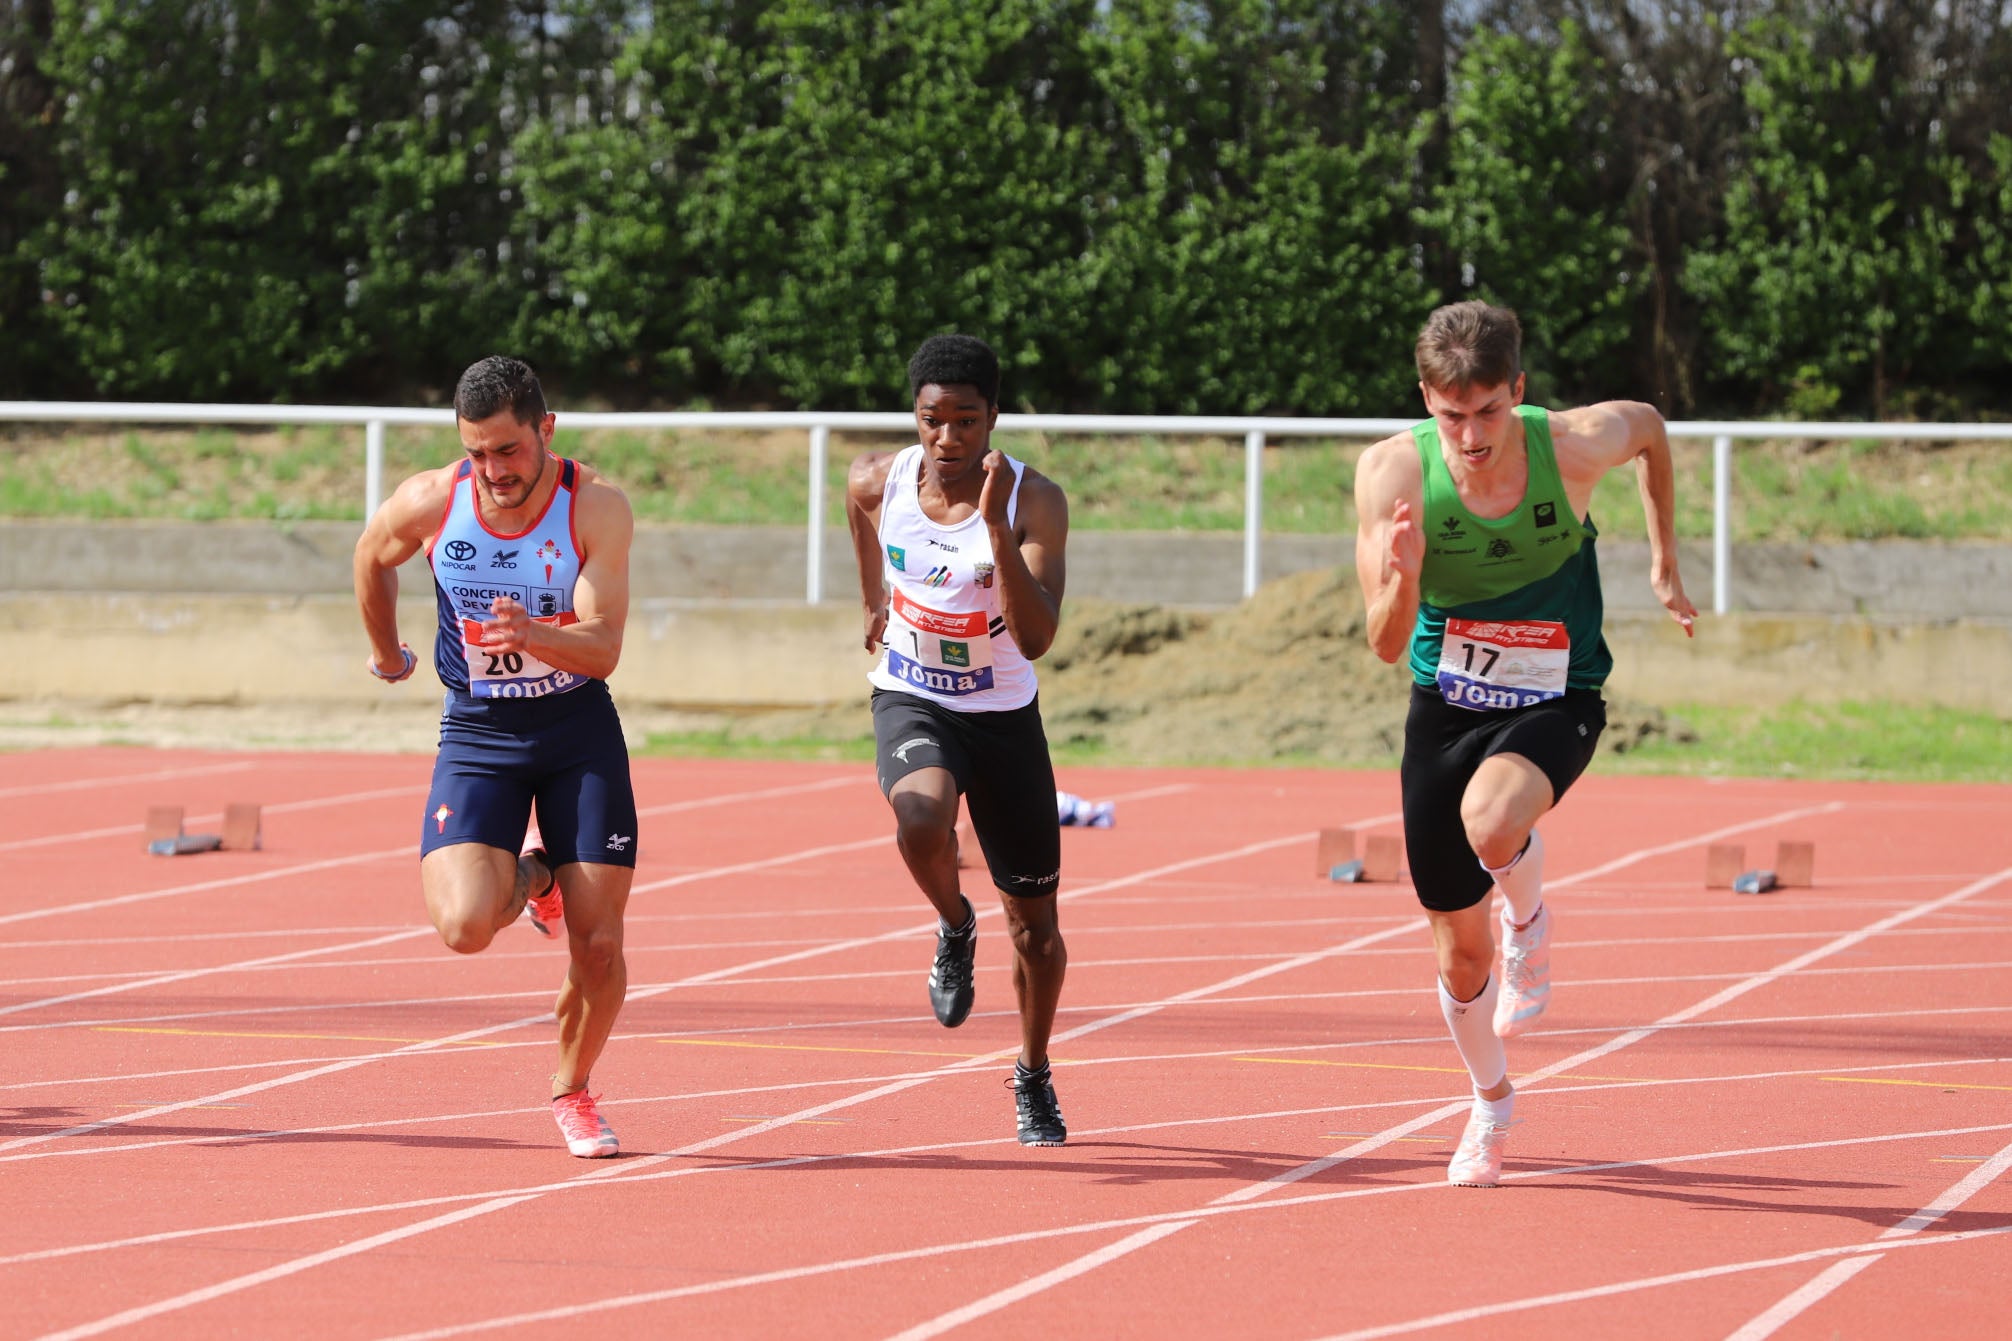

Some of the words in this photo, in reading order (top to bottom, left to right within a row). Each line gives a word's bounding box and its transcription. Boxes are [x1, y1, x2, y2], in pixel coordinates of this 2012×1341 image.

[441, 560, 476, 571] NIPOCAR
[462, 600, 479, 610] DE
[482, 651, 523, 676] 20
[1462, 643, 1500, 677] 17
